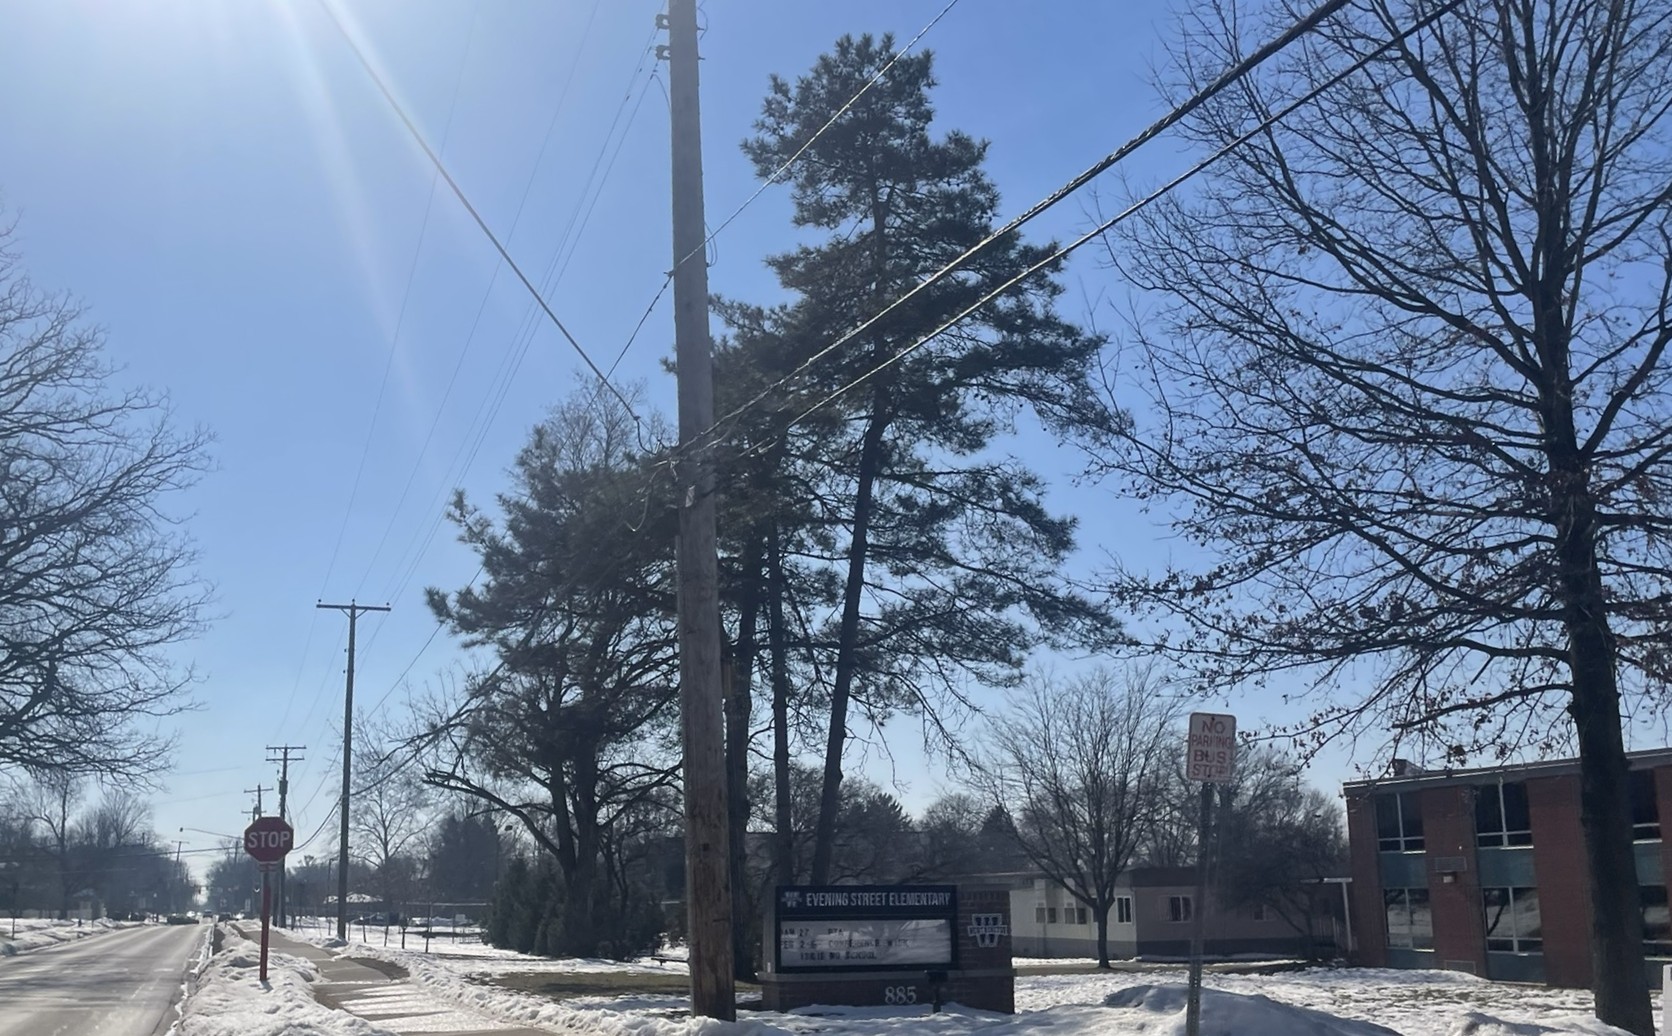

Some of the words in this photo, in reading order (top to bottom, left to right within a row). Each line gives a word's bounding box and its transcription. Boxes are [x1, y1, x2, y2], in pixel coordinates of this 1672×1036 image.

[1202, 720, 1225, 734] NO
[1191, 734, 1231, 749] PARKING
[1194, 749, 1226, 764] BUS
[247, 831, 290, 848] STOP
[806, 892, 849, 907] EVENING
[851, 892, 887, 906] STREET
[889, 892, 951, 906] ELEMENTARY
[845, 951, 877, 960] SCHOOL
[885, 986, 916, 1004] 885
